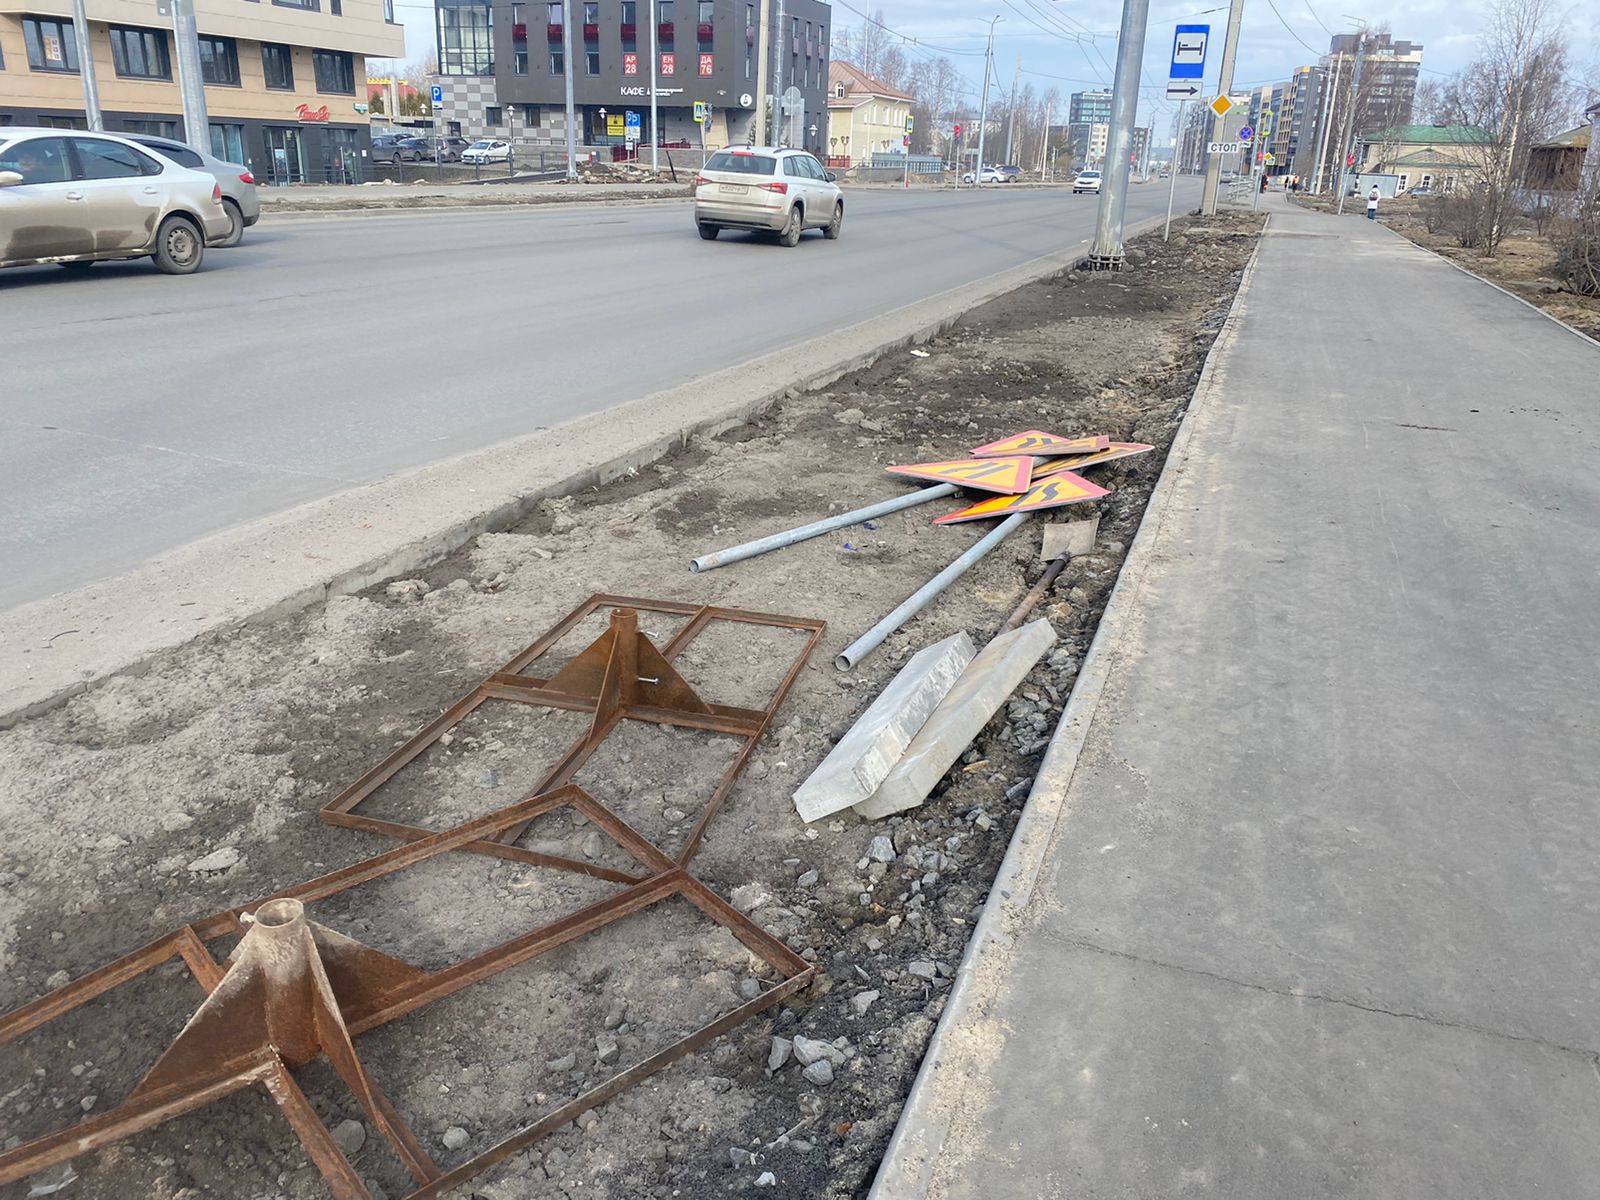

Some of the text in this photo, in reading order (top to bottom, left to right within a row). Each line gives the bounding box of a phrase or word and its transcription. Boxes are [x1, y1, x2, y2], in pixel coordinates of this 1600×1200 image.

[701, 56, 712, 64] ДА
[625, 64, 713, 74] 28 28 76
[620, 87, 645, 96] КАФЕ
[1211, 144, 1237, 152] СТОП
